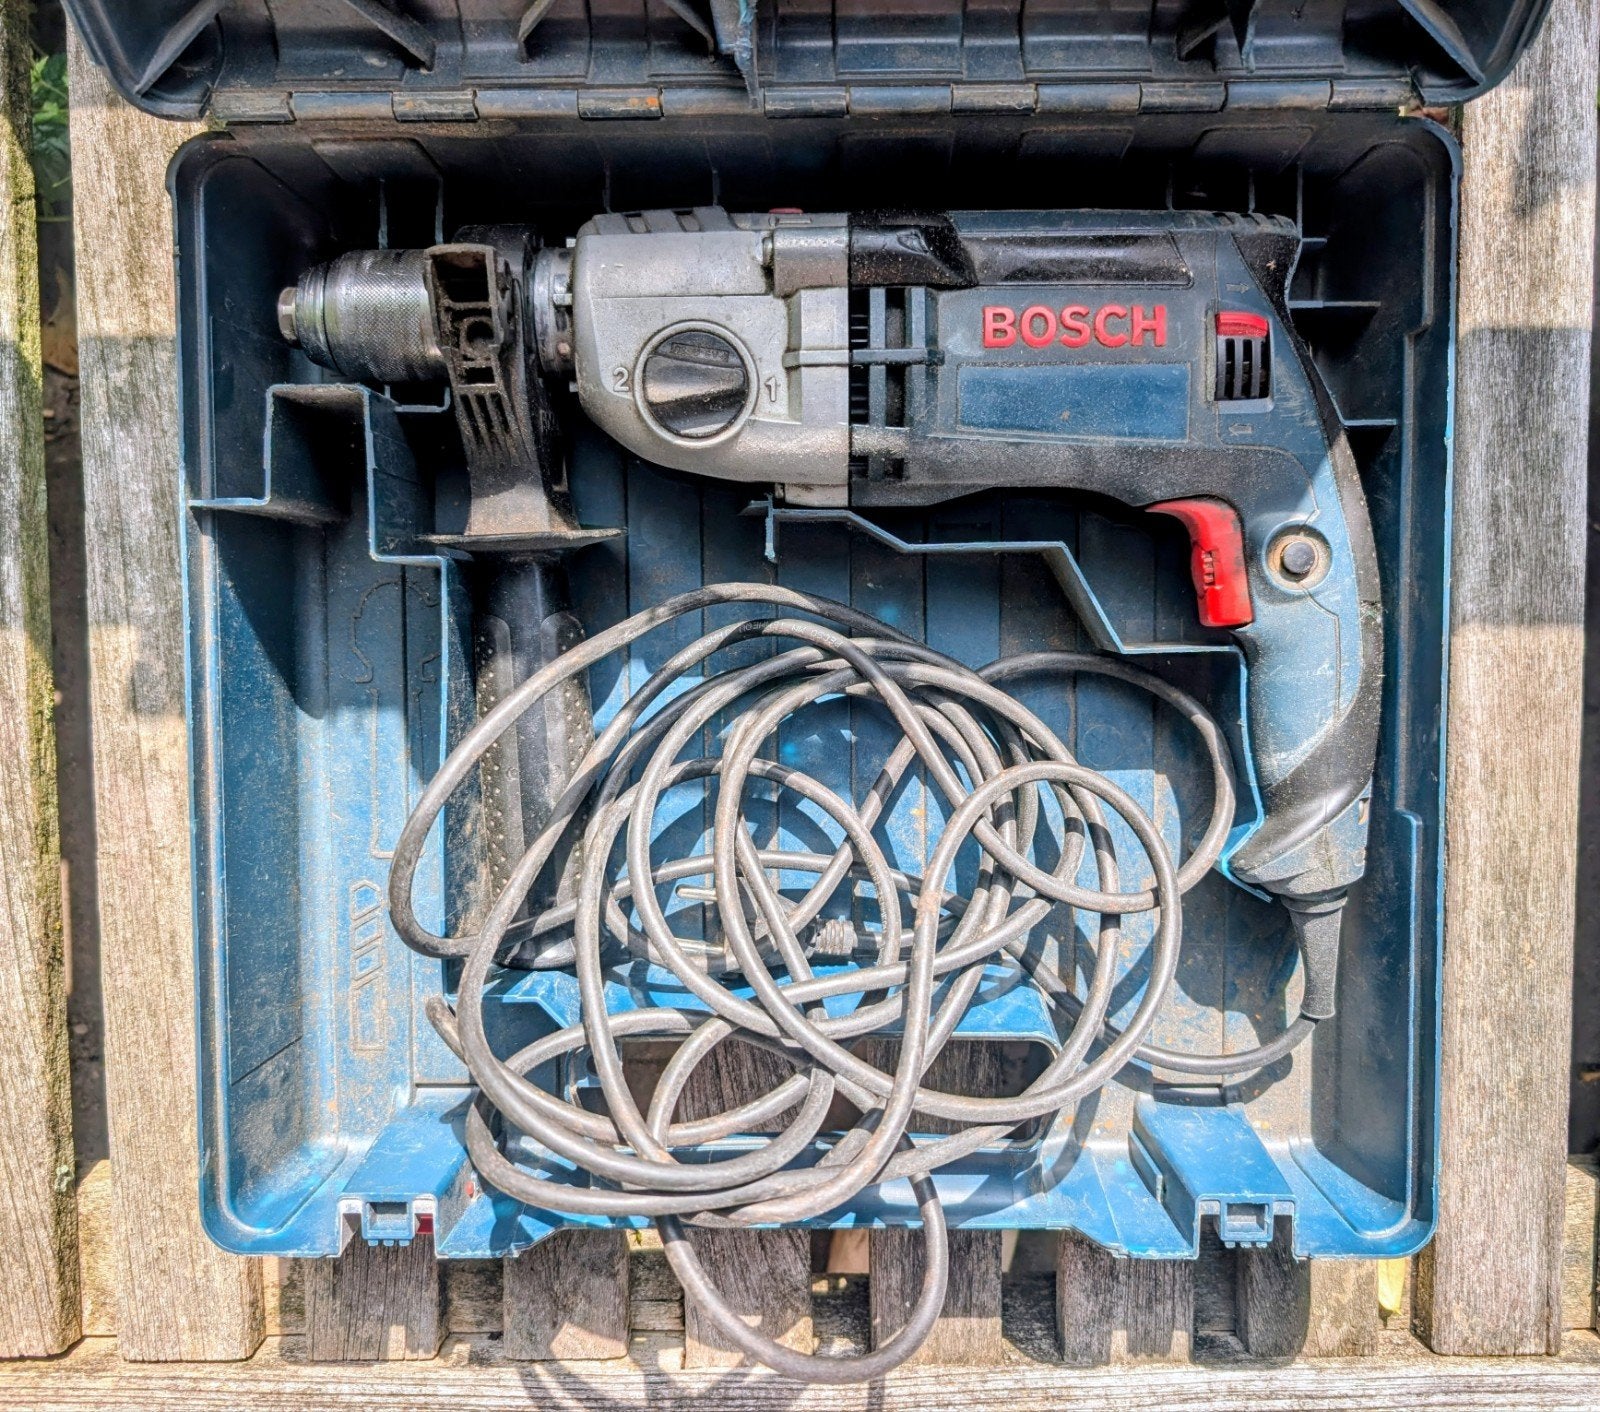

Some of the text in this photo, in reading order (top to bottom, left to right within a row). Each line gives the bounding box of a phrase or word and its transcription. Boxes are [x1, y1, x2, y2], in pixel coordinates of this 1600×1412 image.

[983, 305, 1167, 348] BOSCH
[612, 366, 629, 392] 2
[764, 375, 779, 402] 1
